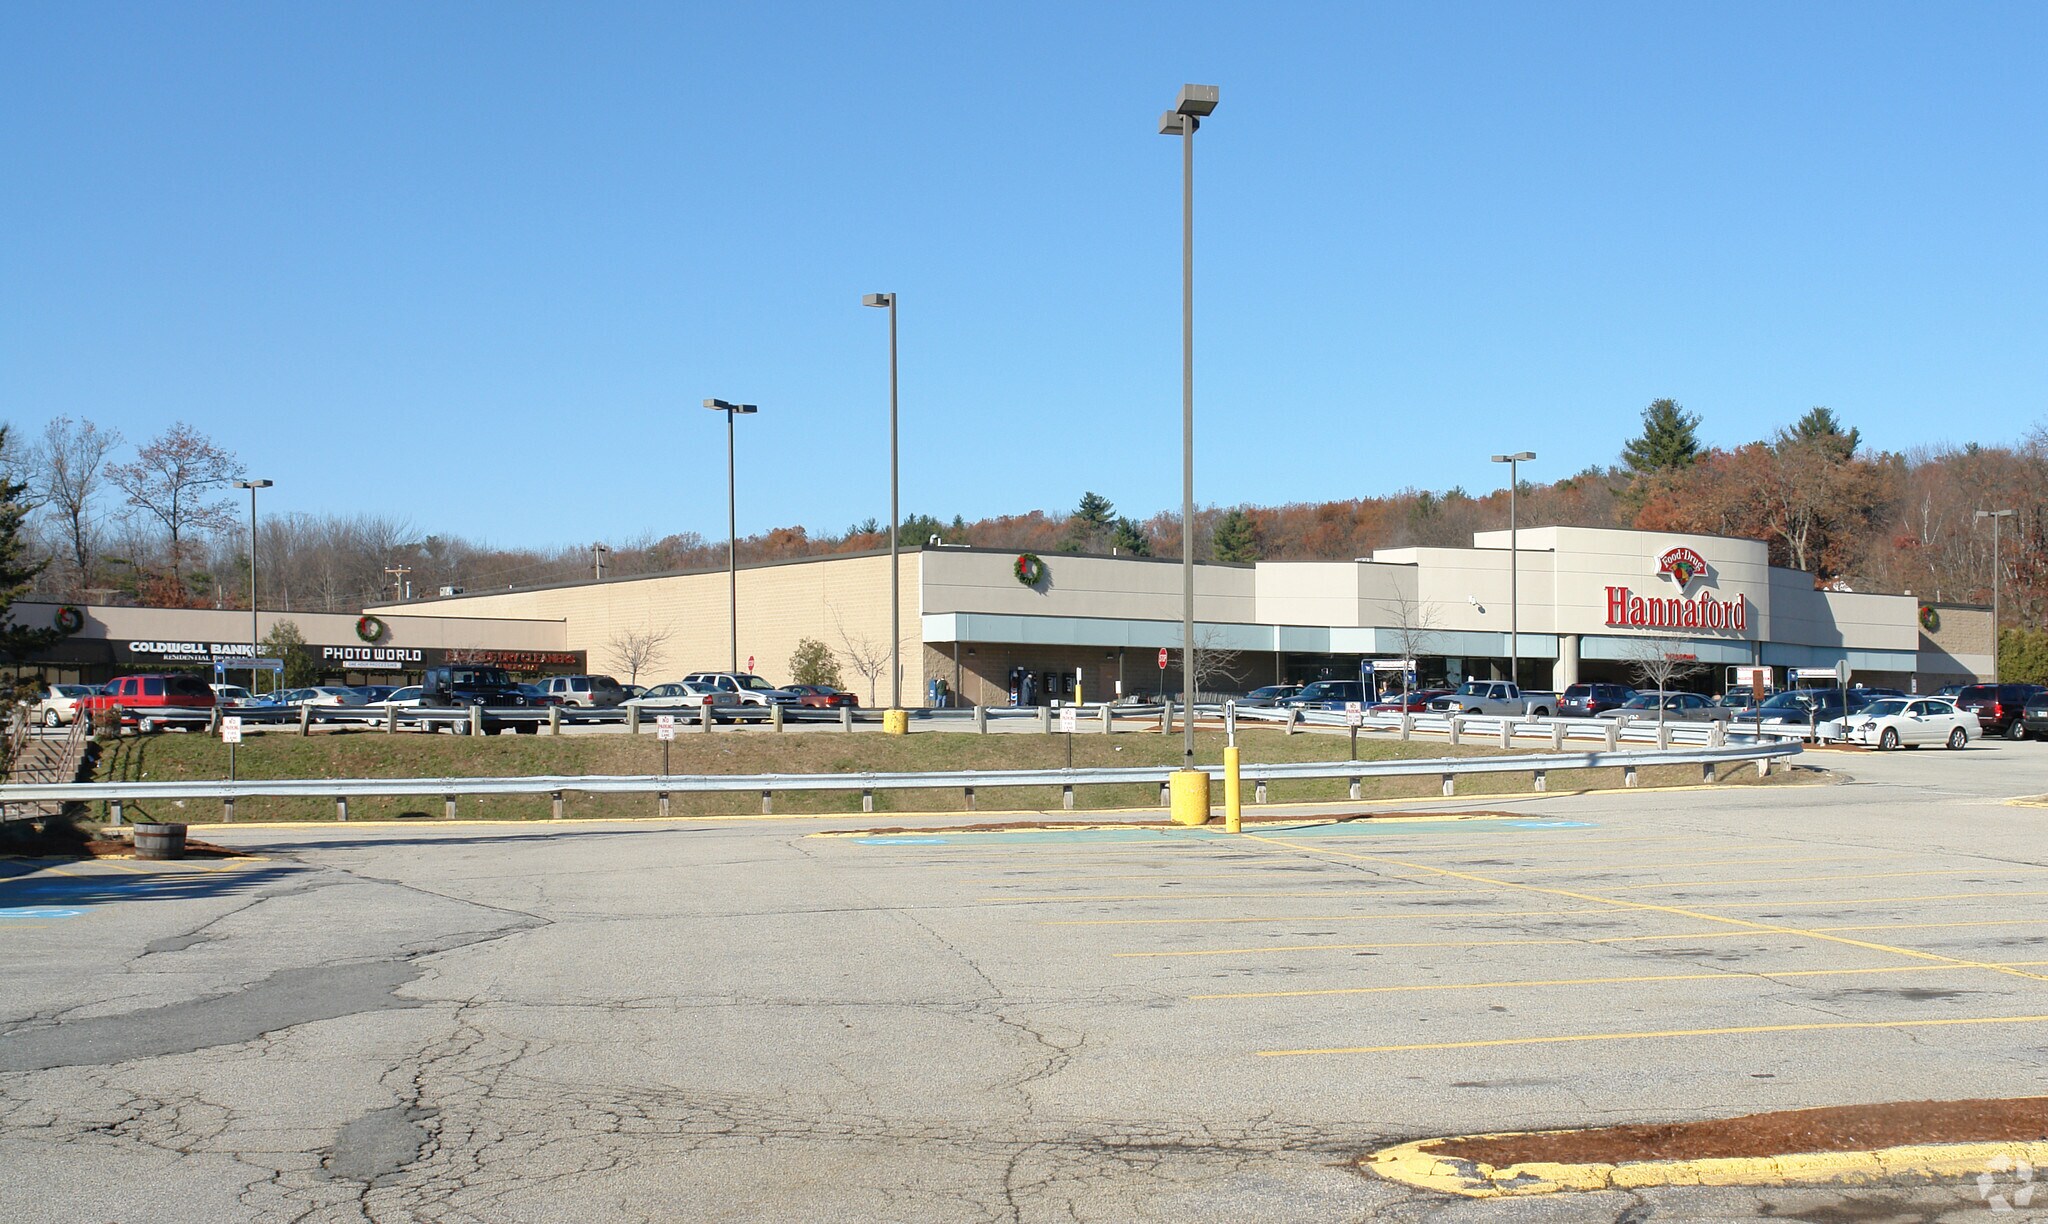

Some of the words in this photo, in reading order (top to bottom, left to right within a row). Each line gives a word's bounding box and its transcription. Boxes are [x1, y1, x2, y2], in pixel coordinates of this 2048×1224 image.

[1605, 586, 1747, 630] Hannaford
[129, 642, 207, 654] COLDWELL
[323, 647, 370, 659] PHOTO
[374, 648, 422, 661] WORLD
[163, 653, 210, 661] RESIDENTIAL
[520, 652, 576, 664] CLEANERS
